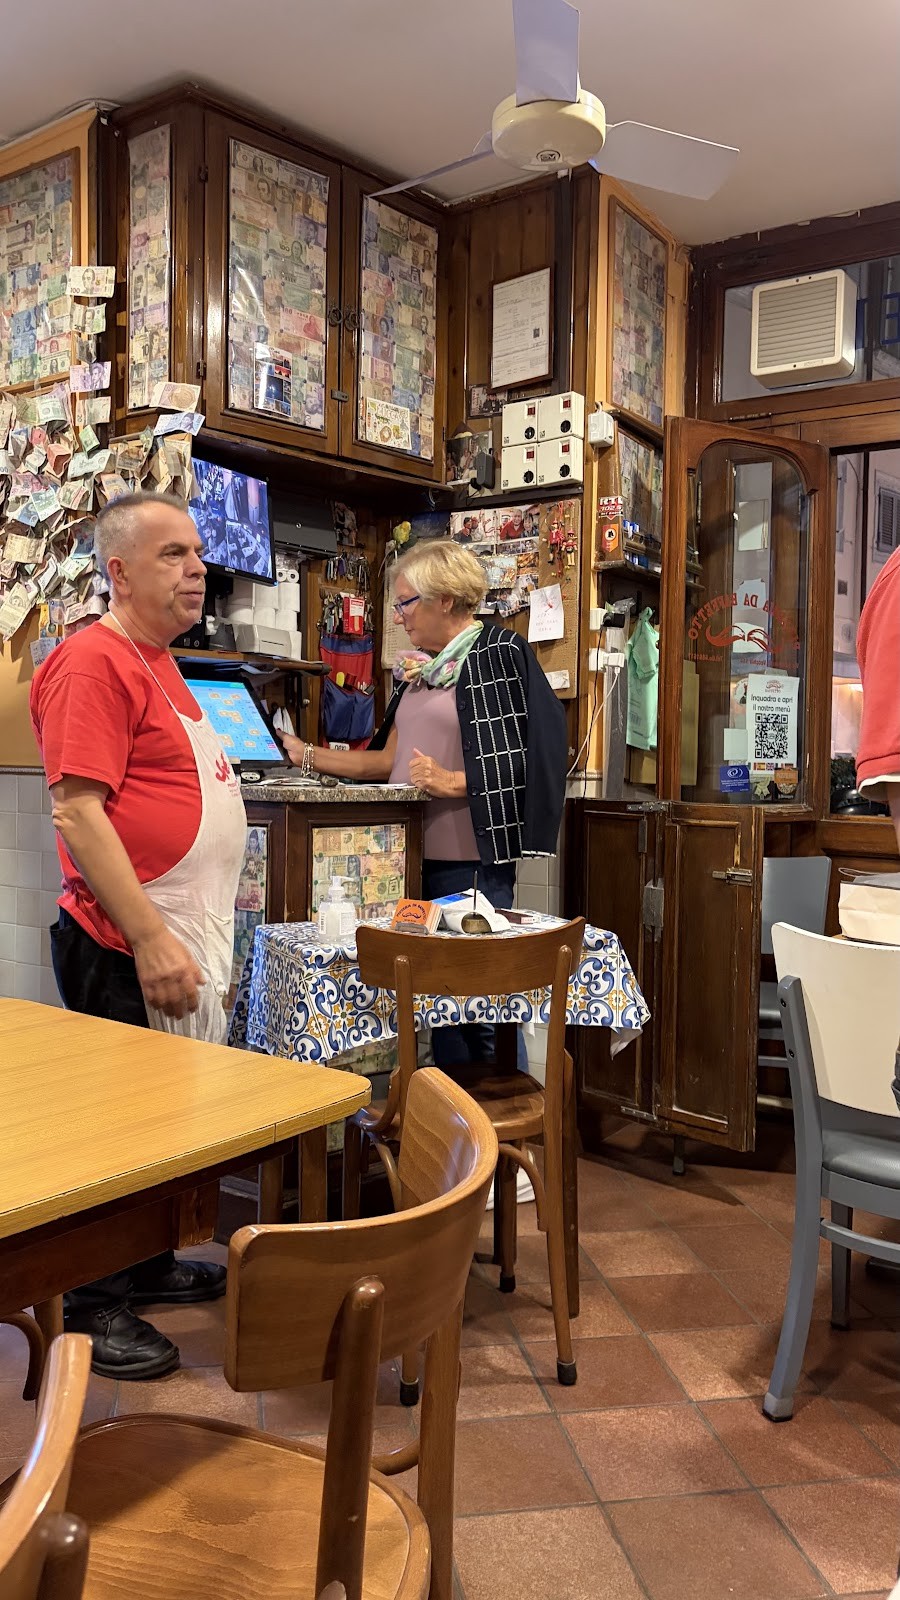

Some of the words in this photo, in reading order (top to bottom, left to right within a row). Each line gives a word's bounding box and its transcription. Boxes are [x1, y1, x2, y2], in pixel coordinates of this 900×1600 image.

[142, 344, 150, 356] 10
[600, 497, 623, 505] RTL
[751, 694, 776, 703] Inquadra
[782, 696, 793, 705] apri
[757, 704, 774, 712] nostro
[775, 705, 790, 713] menù
